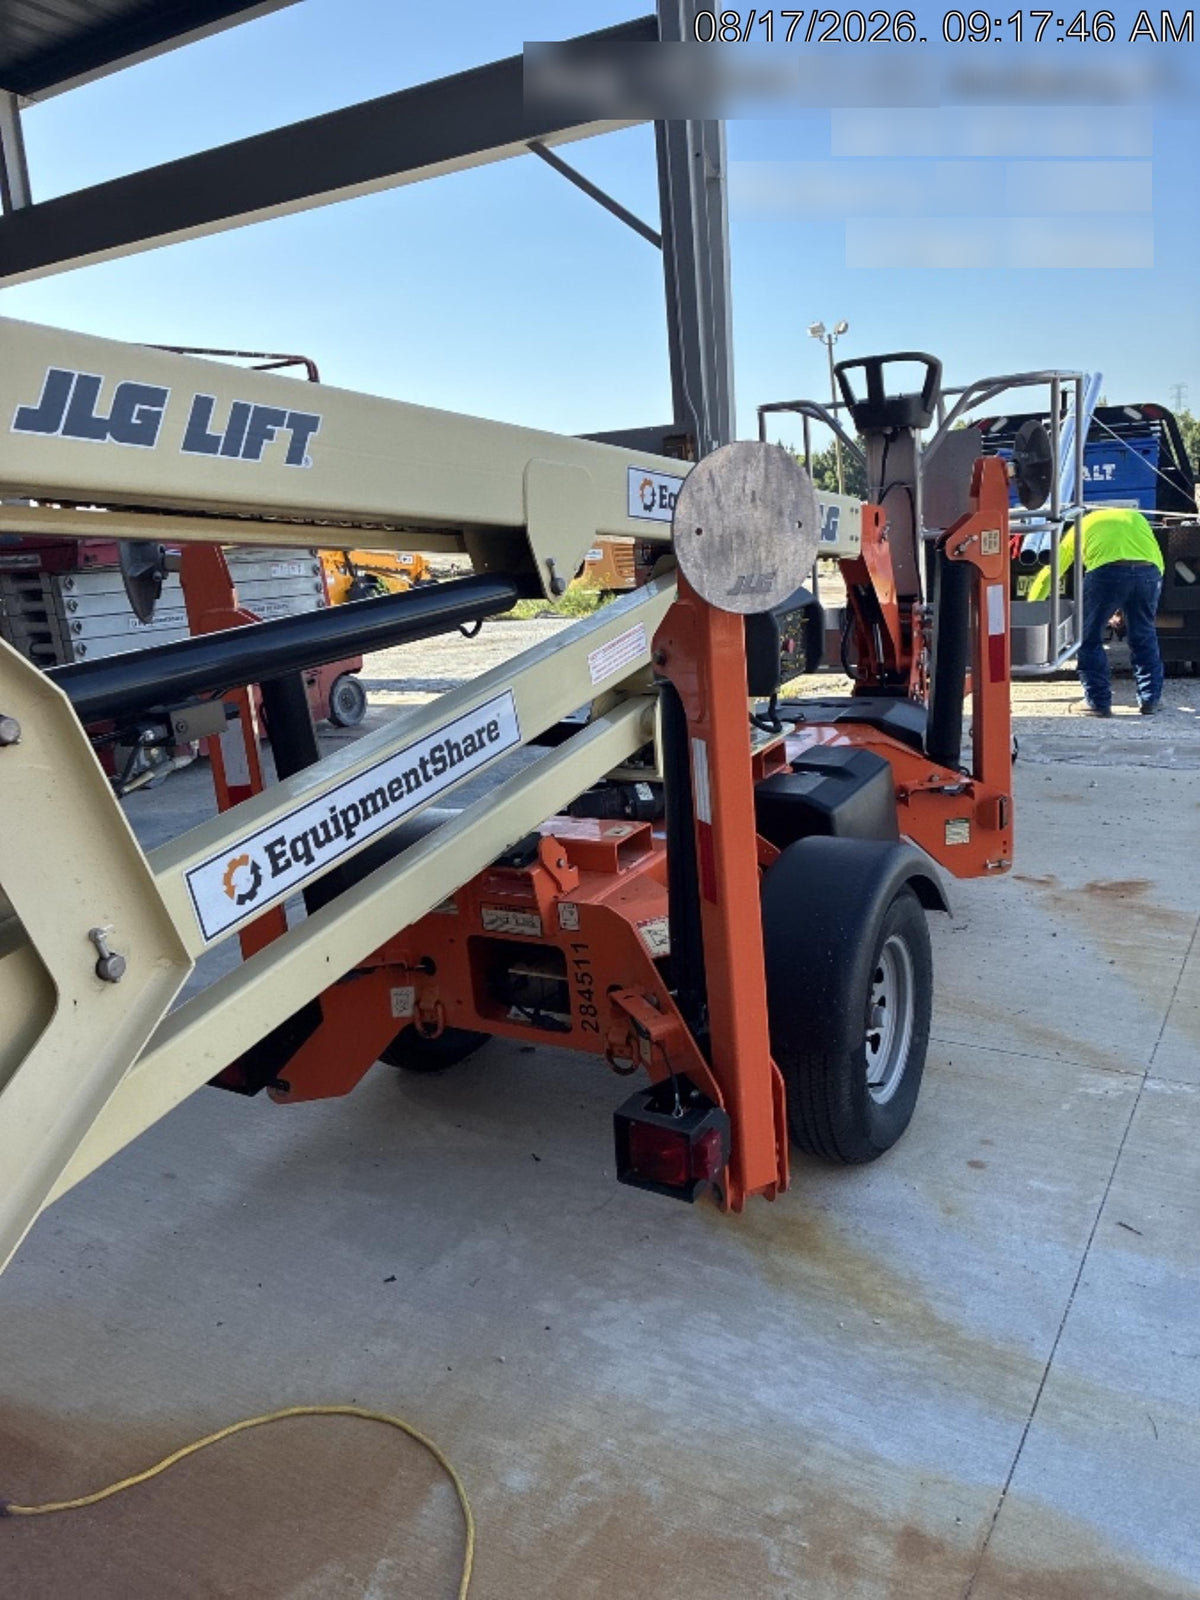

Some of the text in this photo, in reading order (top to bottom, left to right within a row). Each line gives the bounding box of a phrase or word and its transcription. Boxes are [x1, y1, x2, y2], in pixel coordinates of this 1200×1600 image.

[10, 366, 322, 468] JLG LIFT
[263, 717, 501, 879] EquipmentShare
[569, 943, 600, 1034] 284511
